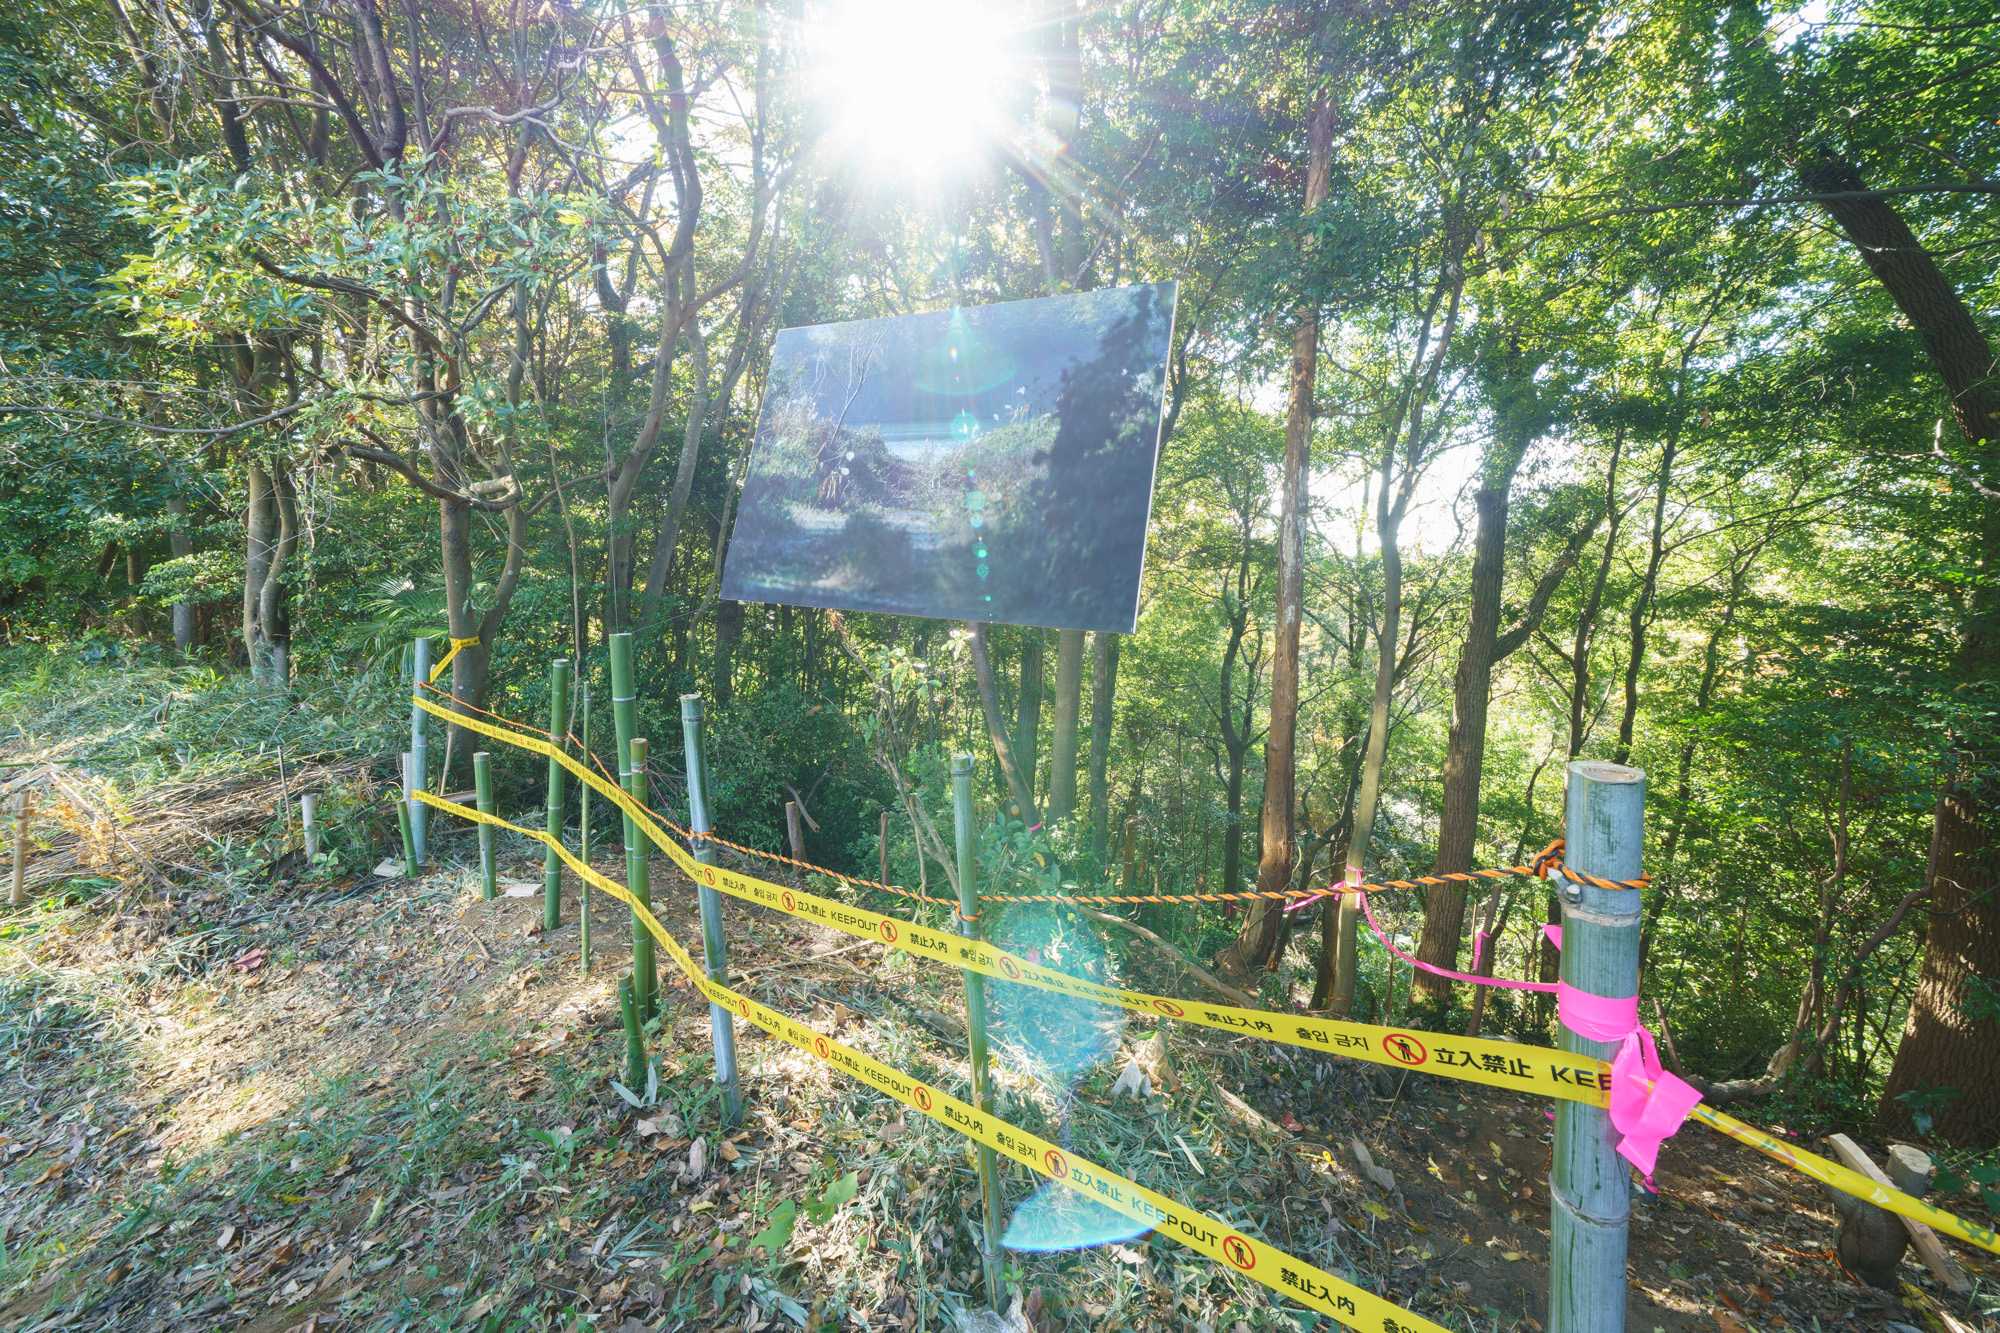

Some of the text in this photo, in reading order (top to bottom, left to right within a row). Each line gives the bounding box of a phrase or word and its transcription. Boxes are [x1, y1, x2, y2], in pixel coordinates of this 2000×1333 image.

[1433, 1047, 1534, 1079] 立入禁止
[1550, 1065, 1612, 1091] KEE
[1071, 1167, 1123, 1203] 立入禁止
